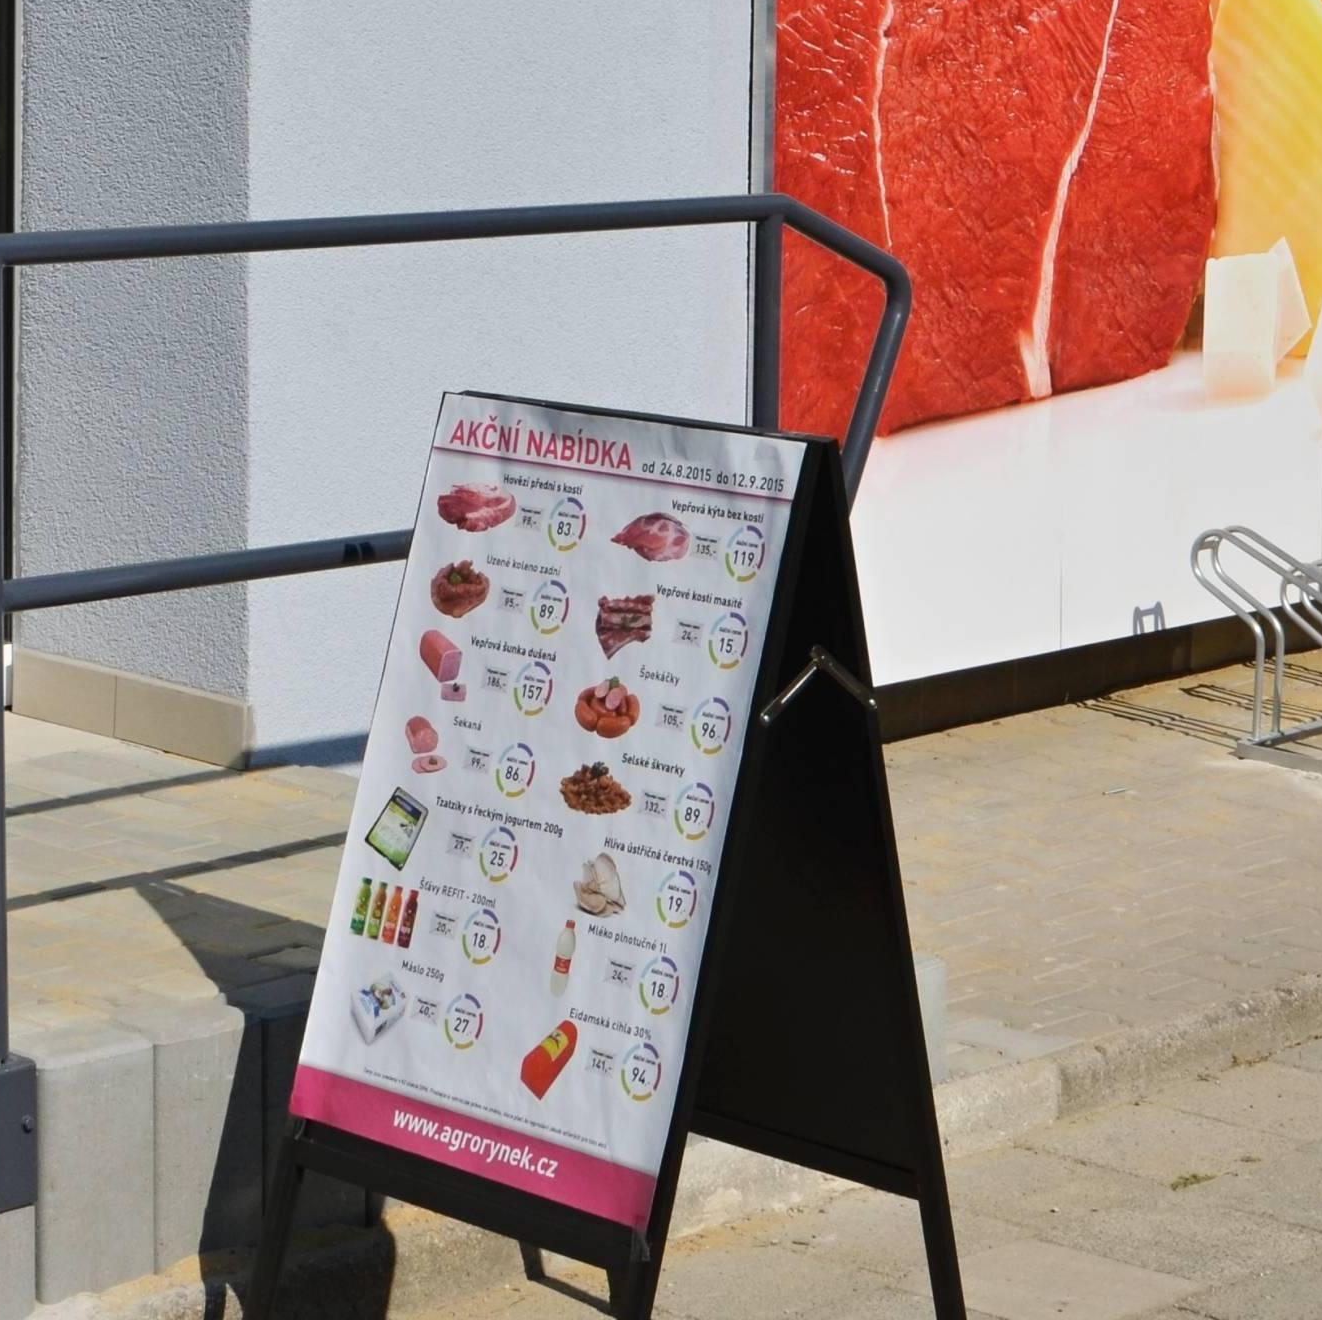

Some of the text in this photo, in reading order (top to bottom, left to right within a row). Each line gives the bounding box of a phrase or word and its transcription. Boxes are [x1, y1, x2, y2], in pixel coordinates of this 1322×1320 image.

[450, 415, 784, 493] AKČNÍ NABÍDKA od 24.8.2015 do 12.9.2015
[503, 473, 529, 488] Hovězí
[557, 484, 562, 492] s
[672, 499, 705, 515] Vepřová
[707, 506, 725, 519] kýta
[727, 508, 742, 520] bez
[487, 554, 561, 576] Uzené koleno zadní
[657, 583, 690, 600] Vepřové
[471, 635, 557, 662] Vepřová šunka dušená
[639, 664, 680, 686] Špekáčky
[453, 716, 482, 731] Sekaná
[622, 753, 686, 777] Selské škvarky
[436, 796, 564, 838] Tzatziky s řeckým jogurtem 200g
[604, 836, 712, 876] Hlíva ústřičná čerstvá 150g
[419, 876, 440, 895] Šťávy
[441, 884, 465, 900] REFIT
[471, 894, 496, 909] 200ml
[588, 924, 612, 940] Mléko
[614, 931, 656, 953] plnotučné
[401, 959, 445, 982] Máslo 250g
[569, 1008, 652, 1041] Eidamská cihla 30%
[393, 1109, 558, 1178] www.agrorynek.cz
